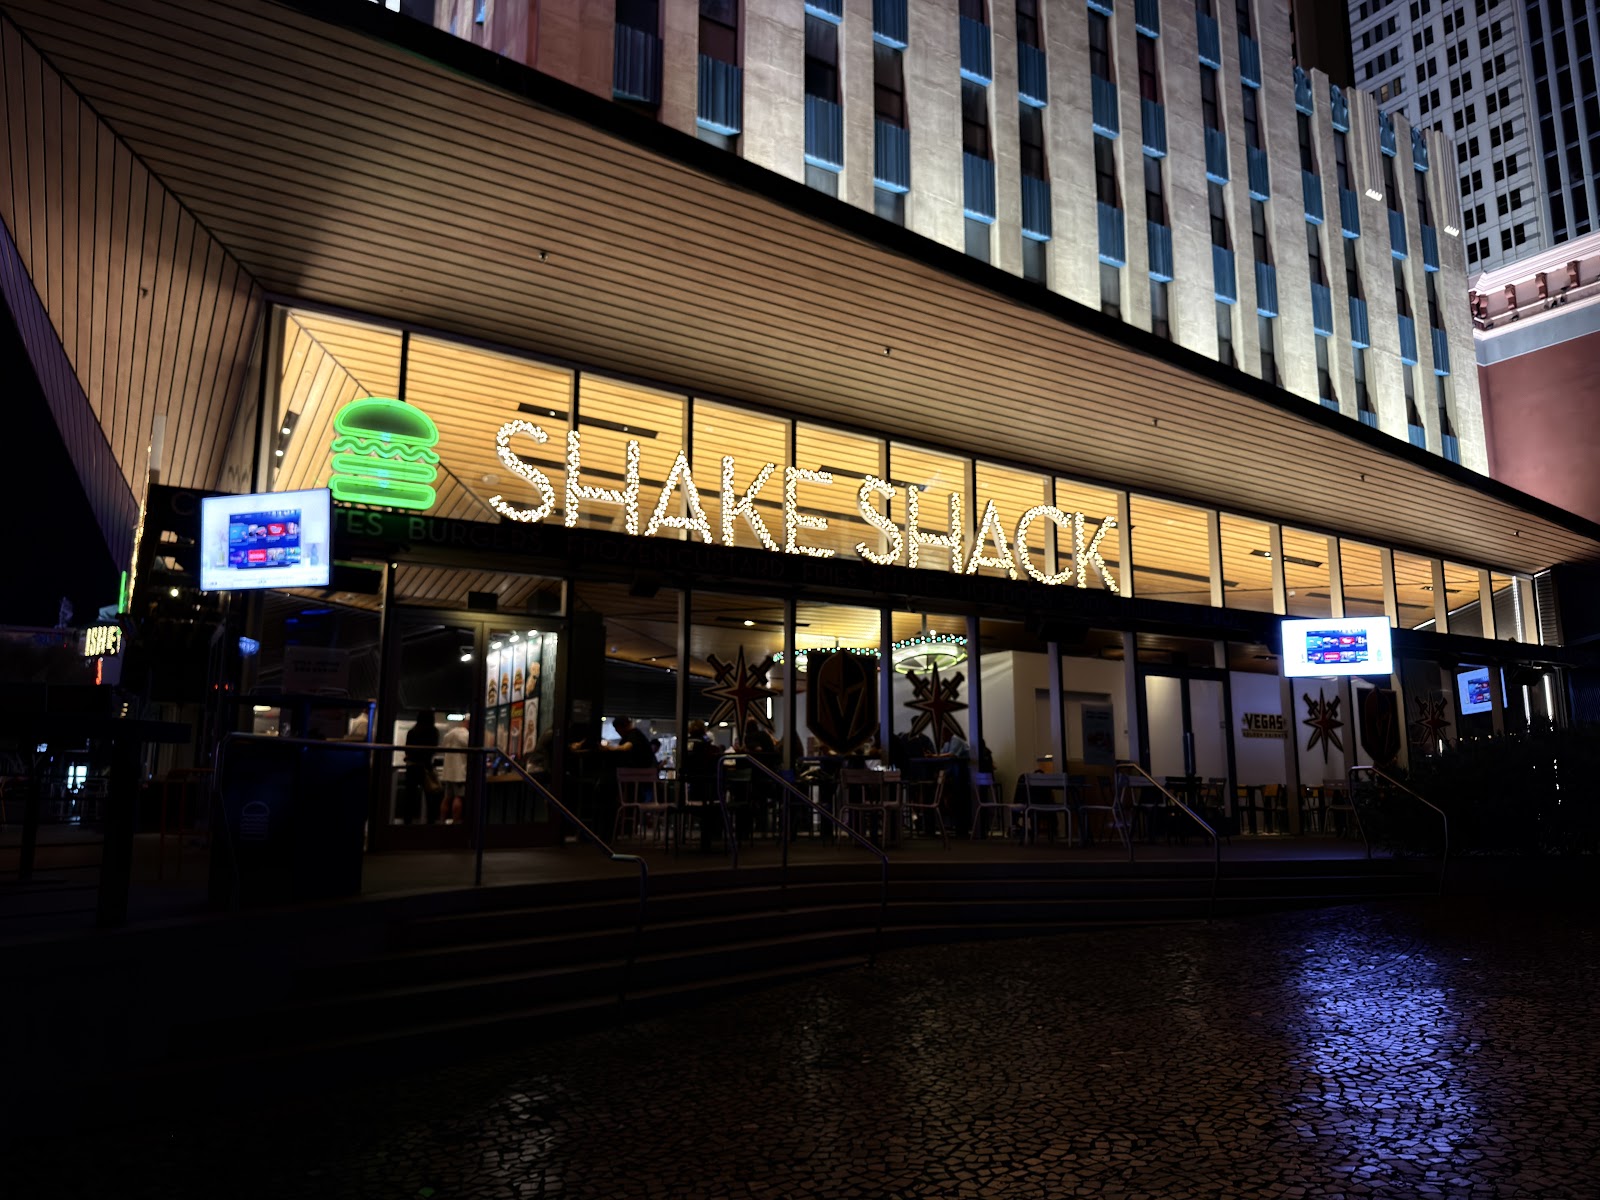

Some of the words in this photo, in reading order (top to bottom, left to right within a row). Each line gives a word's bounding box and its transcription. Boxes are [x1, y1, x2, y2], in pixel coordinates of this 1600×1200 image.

[489, 418, 836, 558] SHAKE
[855, 474, 1121, 592] SHACK
[1244, 713, 1283, 730] VEGAS
